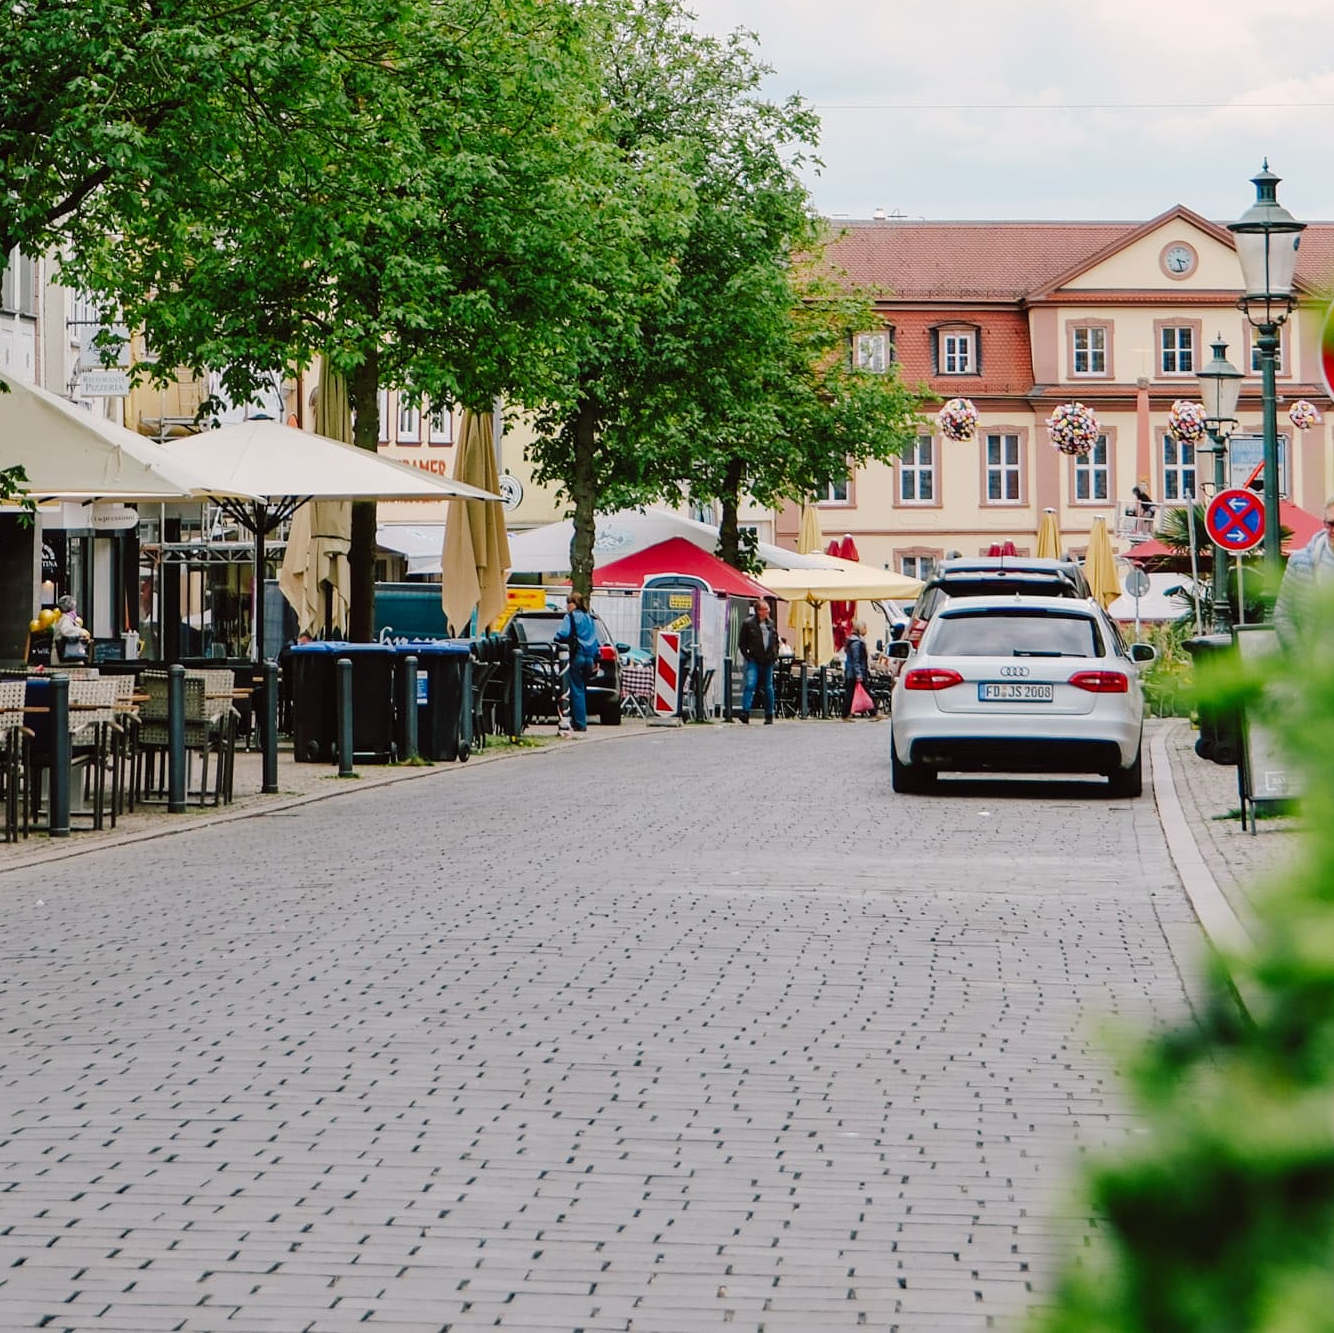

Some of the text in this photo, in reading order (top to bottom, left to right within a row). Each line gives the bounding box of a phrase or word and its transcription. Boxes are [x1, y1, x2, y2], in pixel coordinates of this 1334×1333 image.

[986, 685, 1051, 698] FD JS 2008
